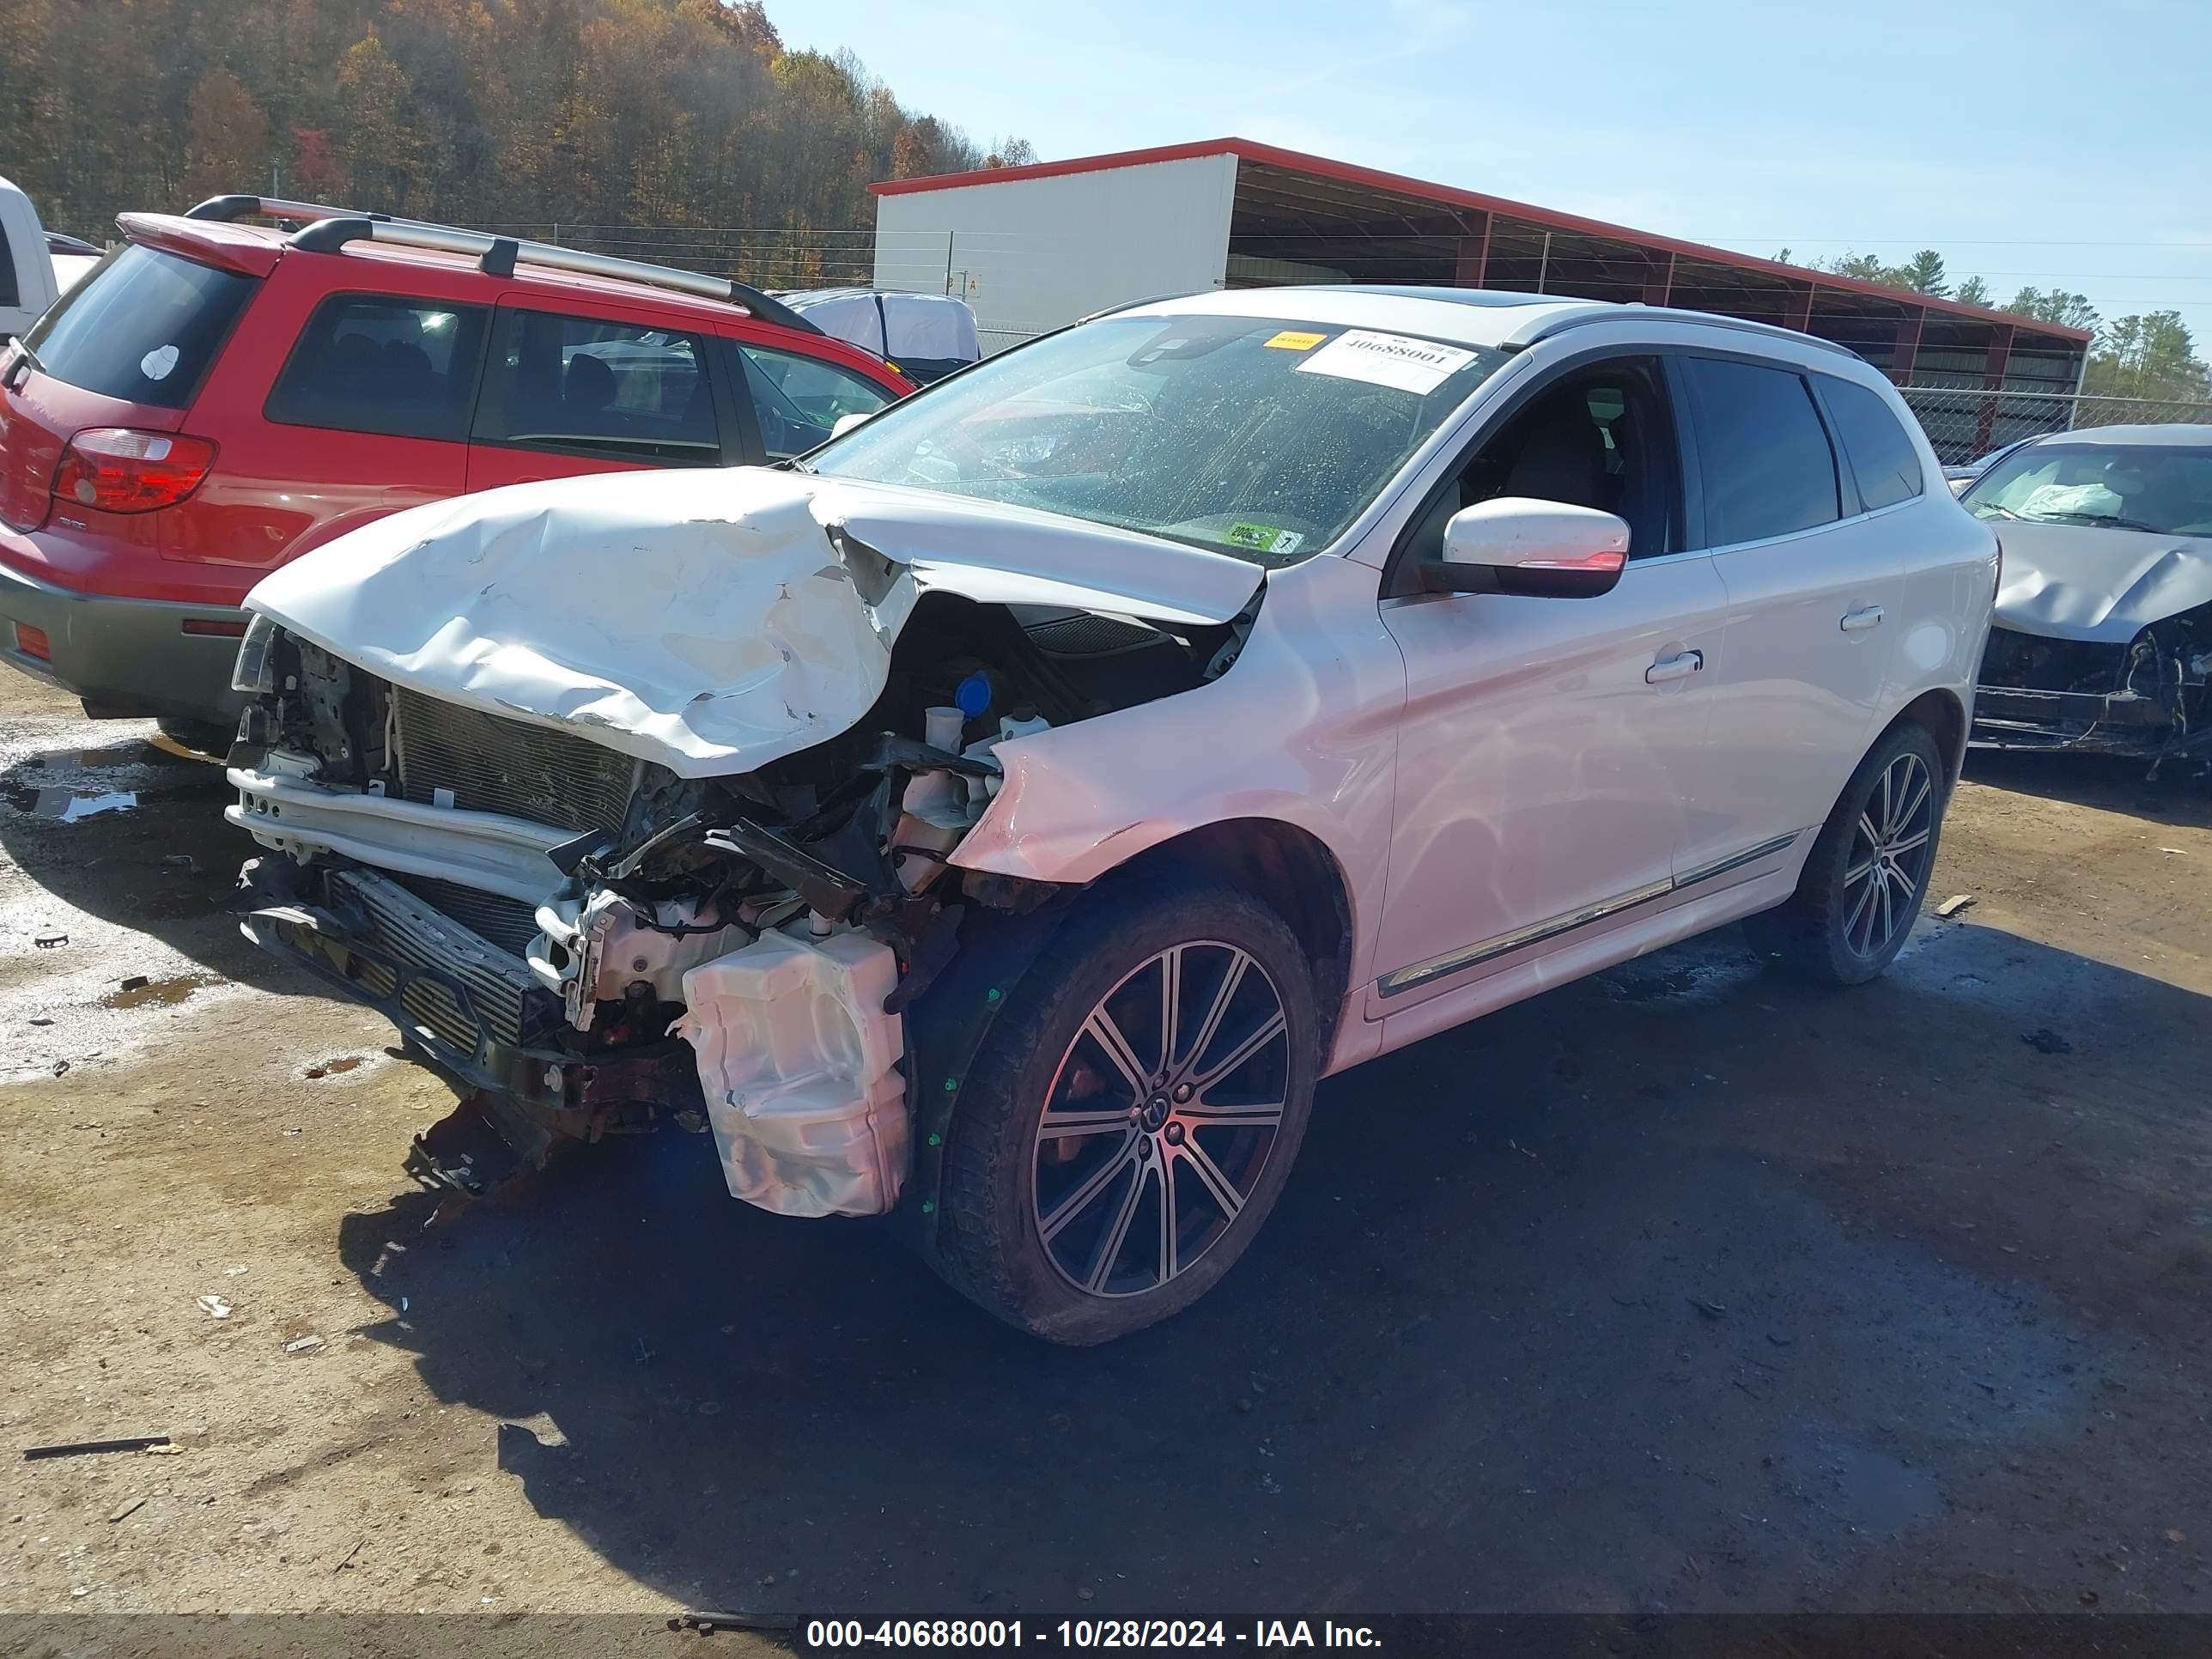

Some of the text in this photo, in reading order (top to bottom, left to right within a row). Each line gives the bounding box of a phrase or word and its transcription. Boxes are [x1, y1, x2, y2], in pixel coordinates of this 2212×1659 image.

[970, 280, 976, 290] A
[1346, 339, 1446, 364] 40688001
[1279, 537, 1292, 549] 7
